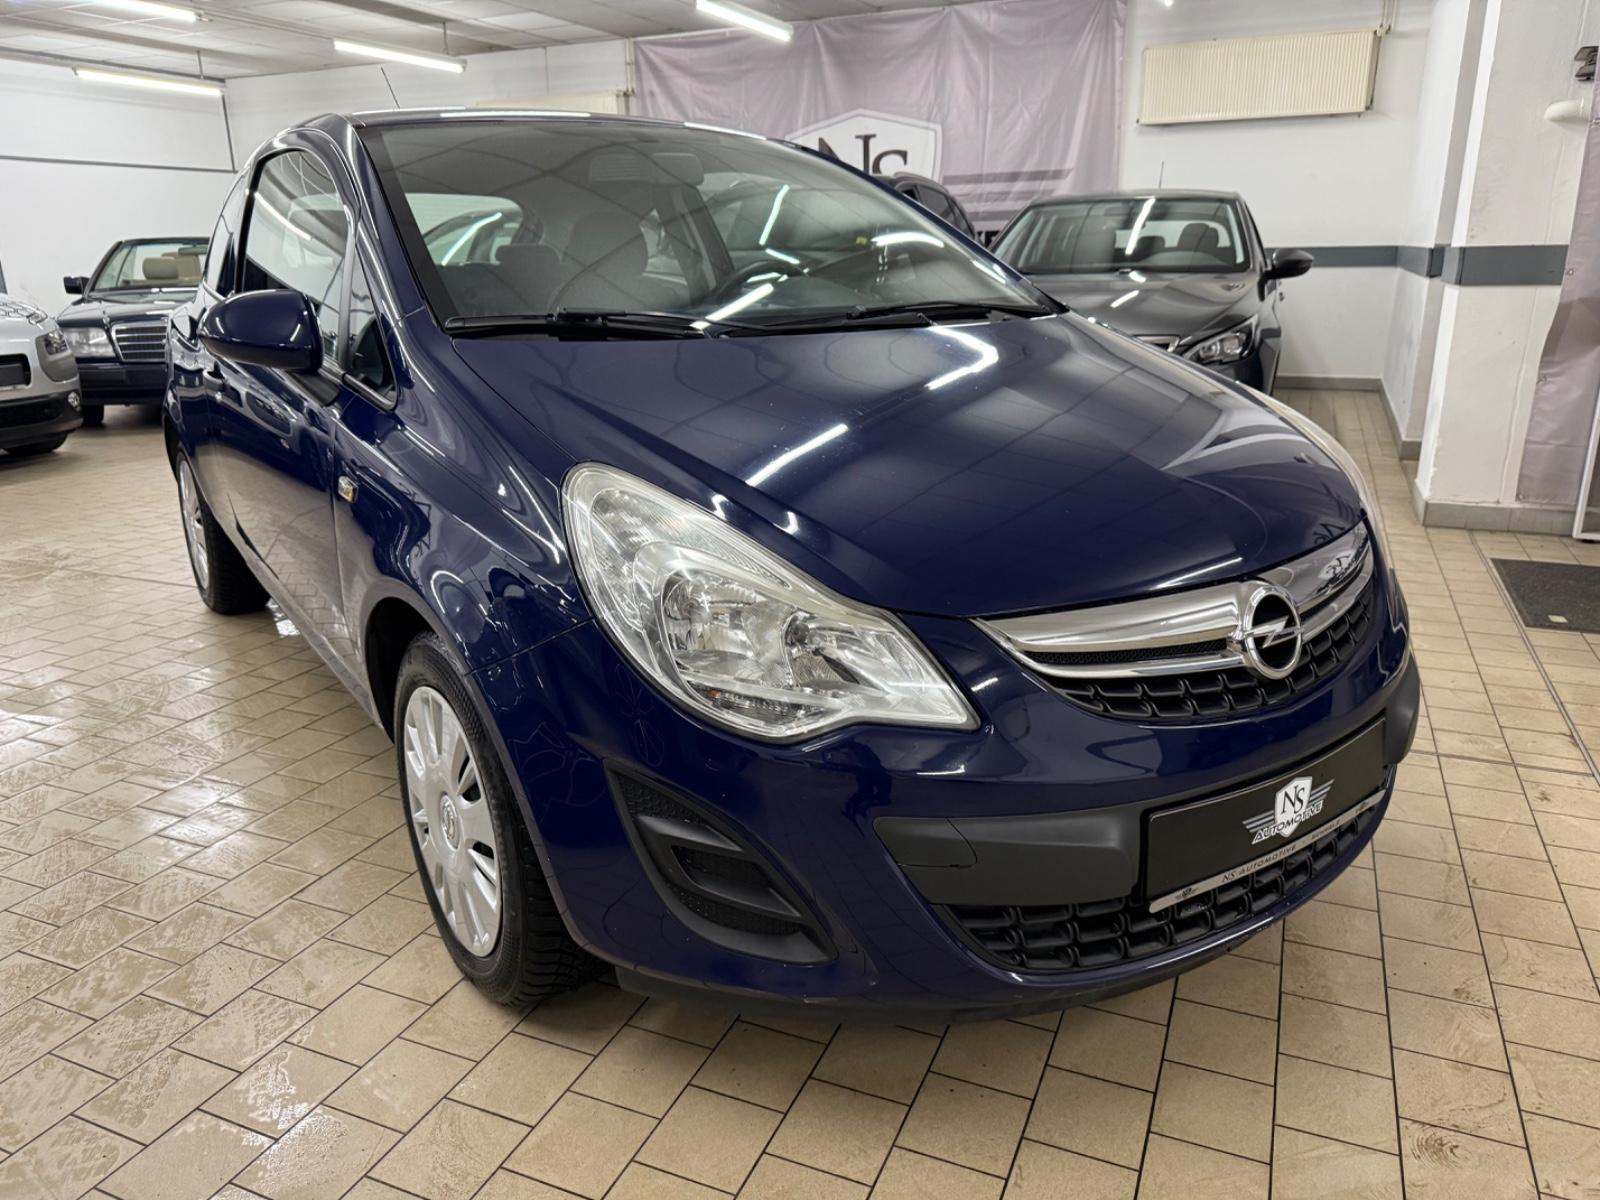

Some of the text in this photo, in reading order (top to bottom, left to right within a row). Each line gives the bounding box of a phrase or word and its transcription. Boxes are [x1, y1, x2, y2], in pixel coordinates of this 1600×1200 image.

[1280, 785, 1305, 814] NS
[1250, 800, 1324, 844] AUTOMOTIVE
[1221, 844, 1297, 883] NS AUTOMOTIVE
